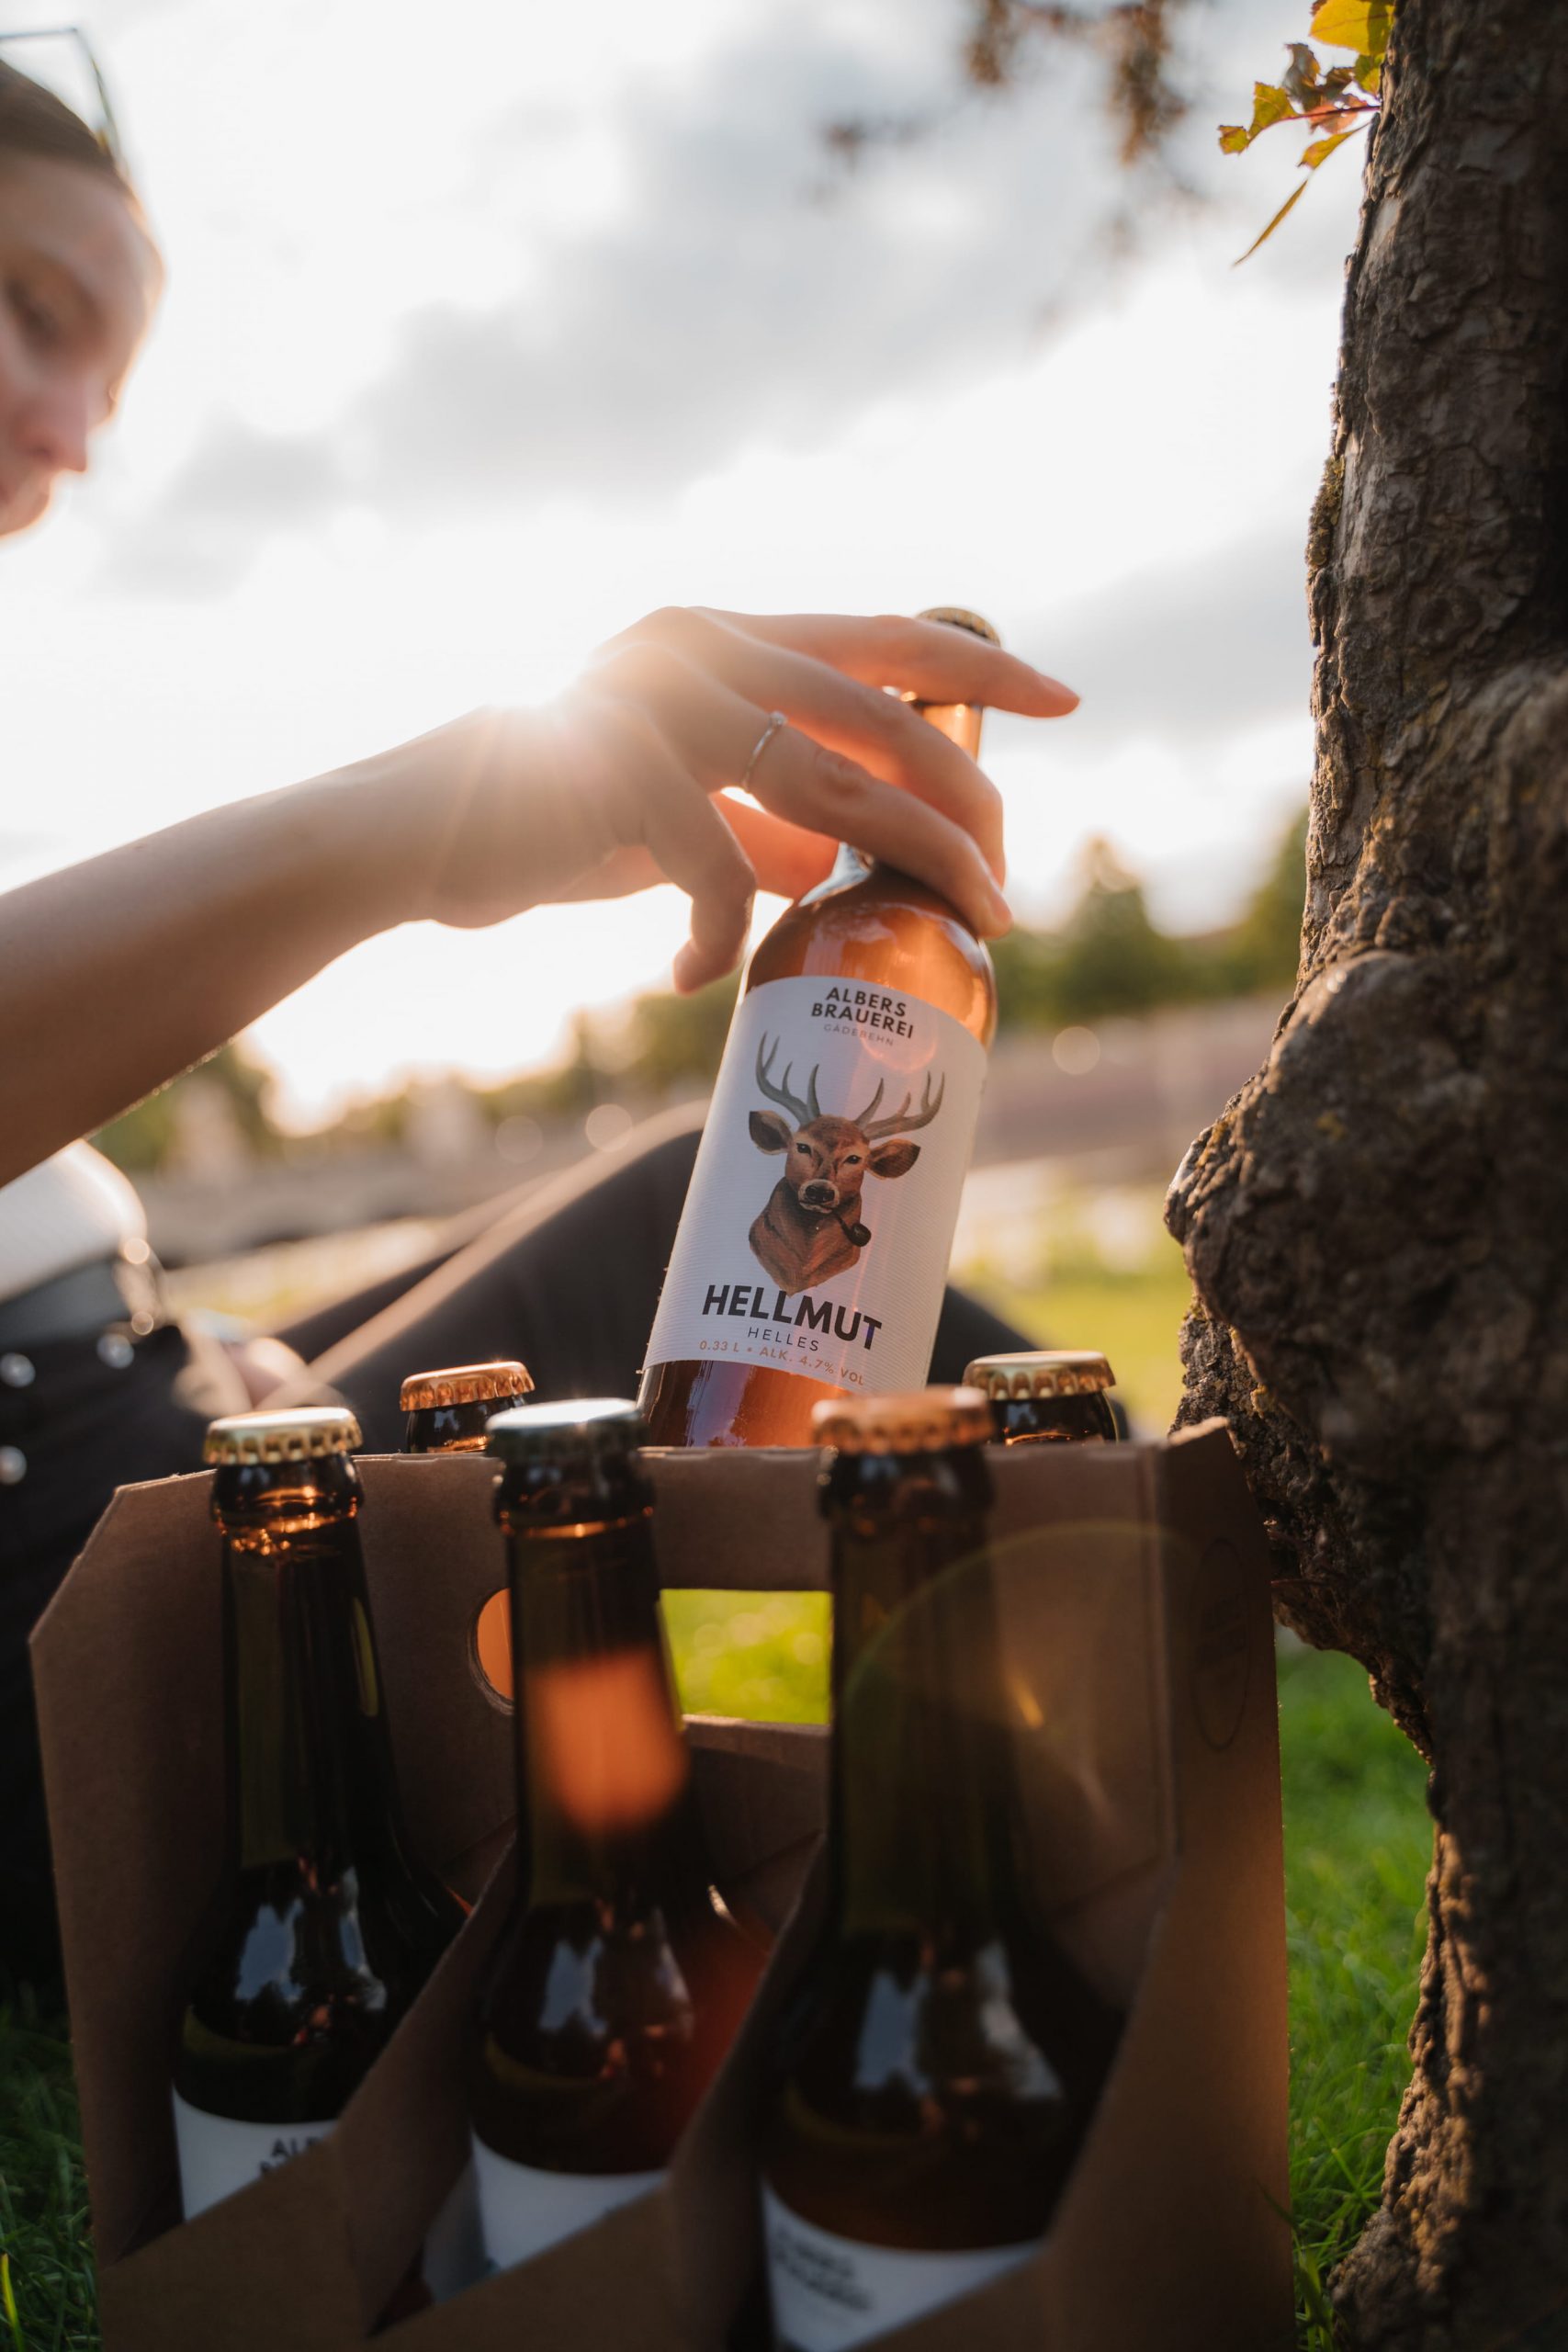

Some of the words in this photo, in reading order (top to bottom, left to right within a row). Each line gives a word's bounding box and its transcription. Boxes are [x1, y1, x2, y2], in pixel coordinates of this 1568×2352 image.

[825, 987, 907, 1018] ALBERS
[811, 1002, 914, 1039] BRAUEREI
[823, 1023, 895, 1047] GADEBEHN
[702, 1284, 883, 1351] HELLMUT
[748, 1327, 819, 1351] HELLES
[699, 1340, 728, 1351] 0.33
[732, 1341, 740, 1352] L
[759, 1347, 794, 1363] ALK.
[798, 1353, 835, 1374] 4.7%
[840, 1366, 865, 1386] VOL
